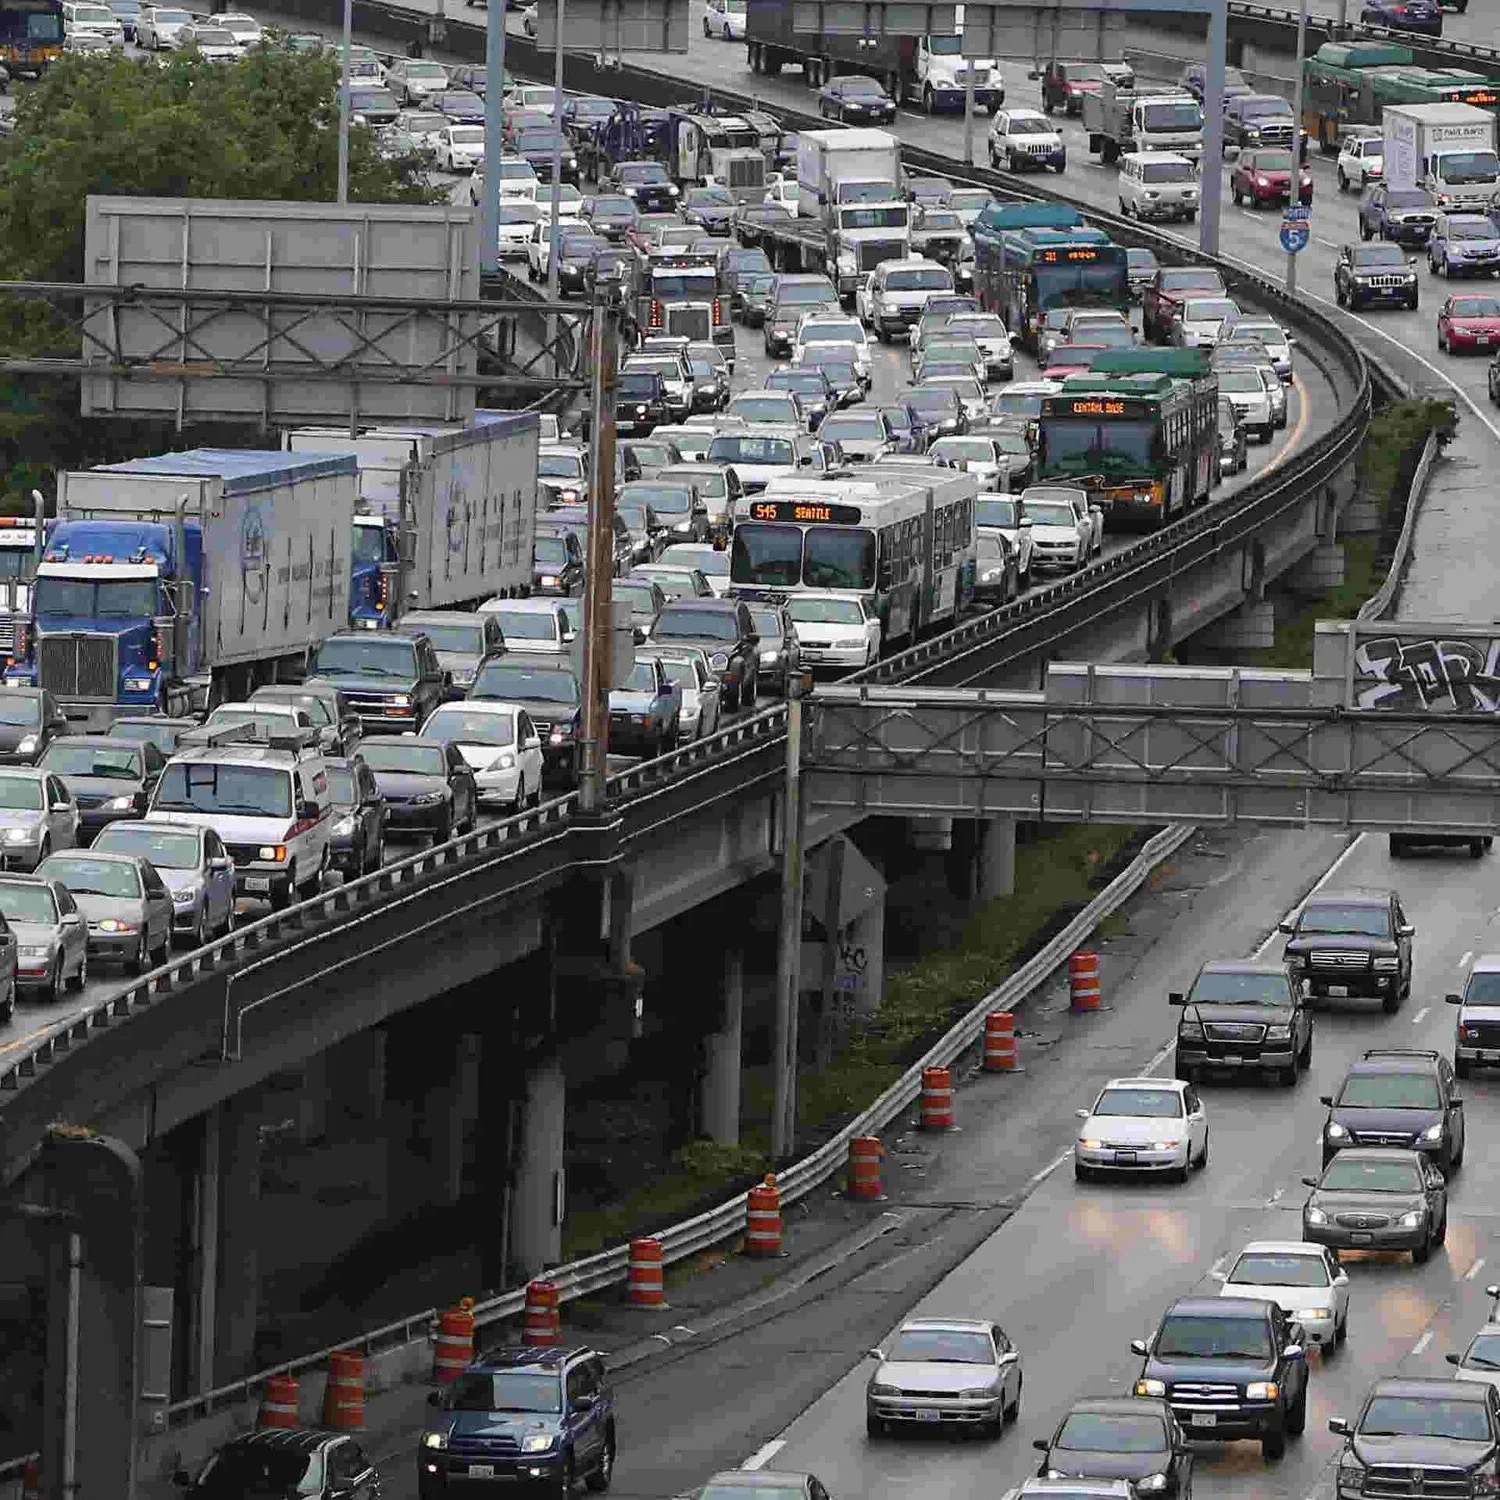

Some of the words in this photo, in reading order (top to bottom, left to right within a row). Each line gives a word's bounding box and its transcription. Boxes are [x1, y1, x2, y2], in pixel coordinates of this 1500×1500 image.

[1289, 230, 1300, 249] 5
[756, 504, 777, 520] 545
[795, 506, 831, 520] SEATTLE
